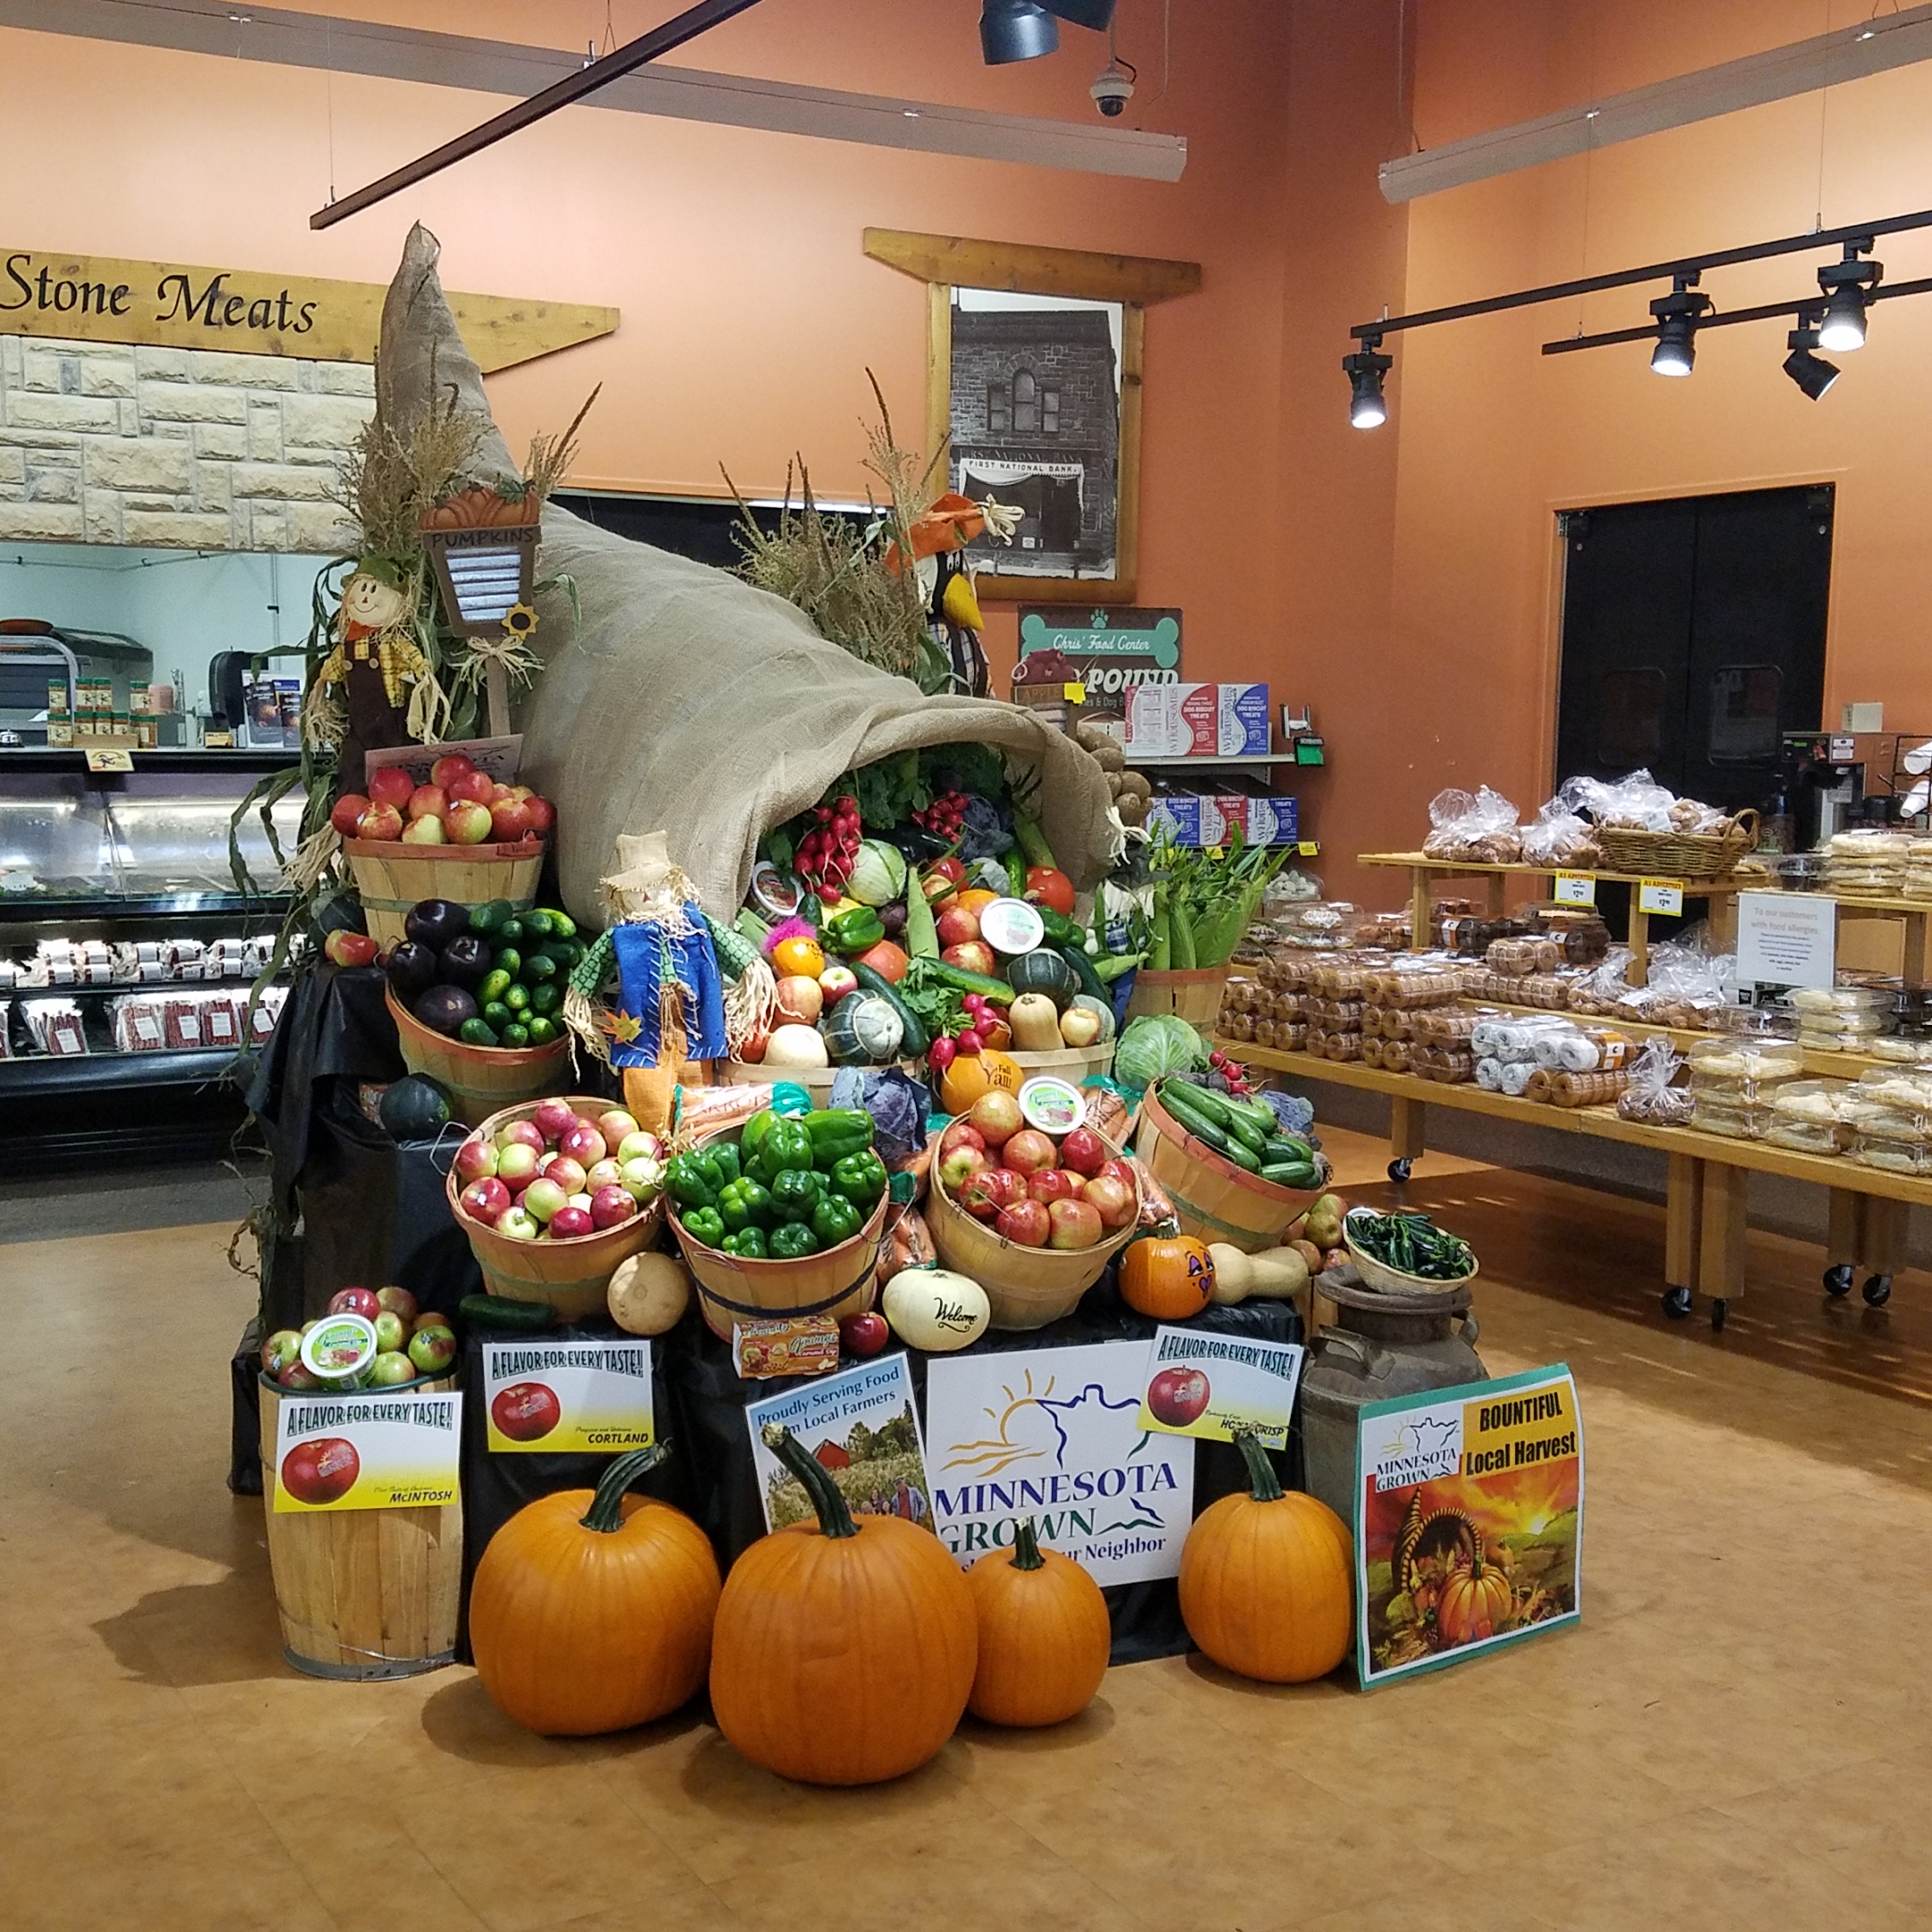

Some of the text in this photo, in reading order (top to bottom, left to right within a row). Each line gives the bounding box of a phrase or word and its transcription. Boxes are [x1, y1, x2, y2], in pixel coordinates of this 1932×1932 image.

[0, 254, 318, 334] Stone Meats
[969, 460, 996, 470] FIRST
[999, 462, 1045, 473] NATIONAL
[430, 527, 535, 548] PUMPKINS
[1053, 633, 1151, 651] Chris' Food Center
[1103, 697, 1118, 709] Dog
[1751, 921, 1767, 929] with
[1769, 922, 1787, 931] food
[1754, 907, 1764, 916] To
[1779, 911, 1818, 921] customers
[998, 1063, 1012, 1076] Fall
[933, 1296, 979, 1326] Welcome
[492, 1349, 644, 1380] A FLAVOR FOR EVERY TASTE!
[1157, 1334, 1296, 1381] A FLAVOR FOR EVERY TASTE!
[757, 1366, 900, 1428] Proudly Serving Food
[804, 1406, 840, 1430] Local
[843, 1390, 896, 1416] Farmers
[1479, 1391, 1563, 1433] BOUNTIFUL
[286, 1401, 453, 1437] A FLAVOR FOR EVERY TASTE!
[588, 1433, 649, 1444] CORTLAND
[1465, 1430, 1576, 1477] Local Harvest
[1376, 1447, 1457, 1477] MINNESOTA
[934, 1462, 1179, 1519] MINNESOTA
[1376, 1468, 1431, 1492] GROWN
[389, 1490, 453, 1504] McINTOSH
[940, 1507, 1097, 1555] GROWN
[1061, 1536, 1167, 1562] ur Neighbor
